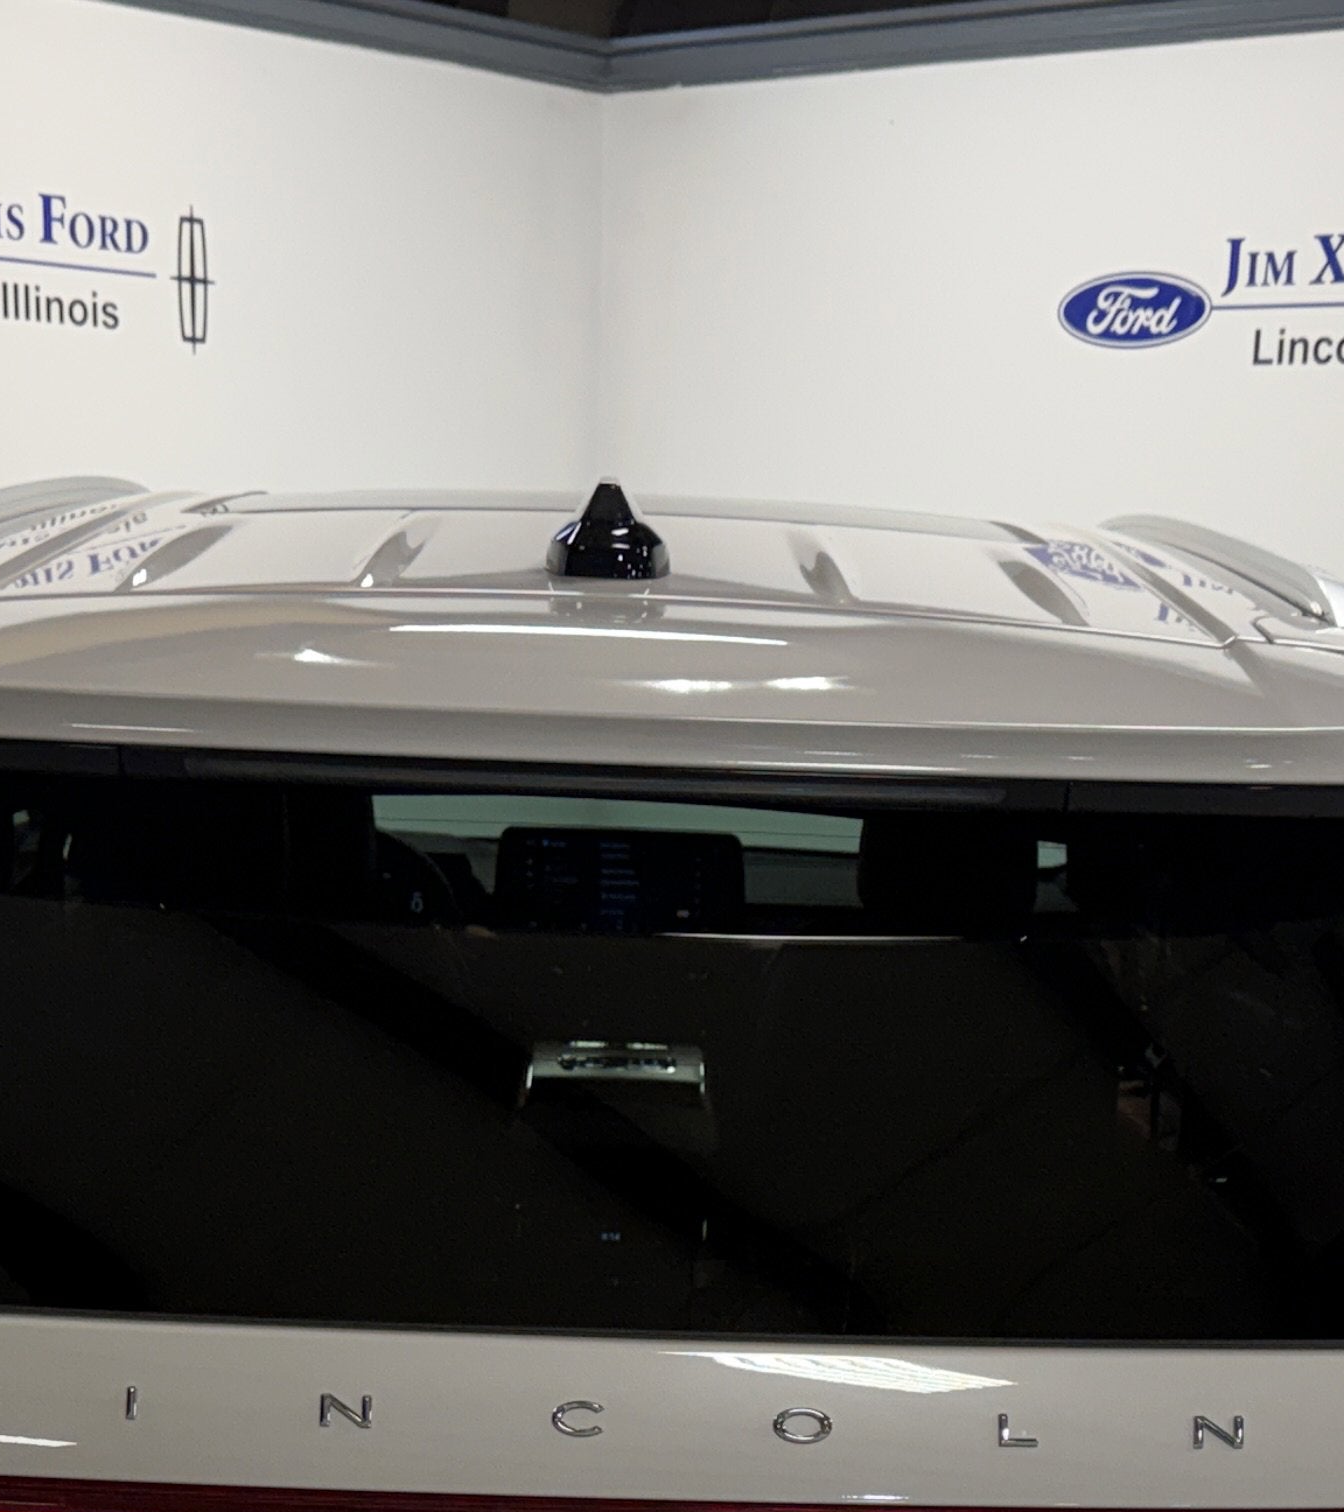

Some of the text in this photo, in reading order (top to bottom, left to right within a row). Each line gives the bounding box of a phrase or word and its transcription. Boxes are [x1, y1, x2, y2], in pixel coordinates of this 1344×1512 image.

[39, 193, 149, 253] FORD
[1, 281, 119, 330] Illinois
[1086, 285, 1178, 336] Ford
